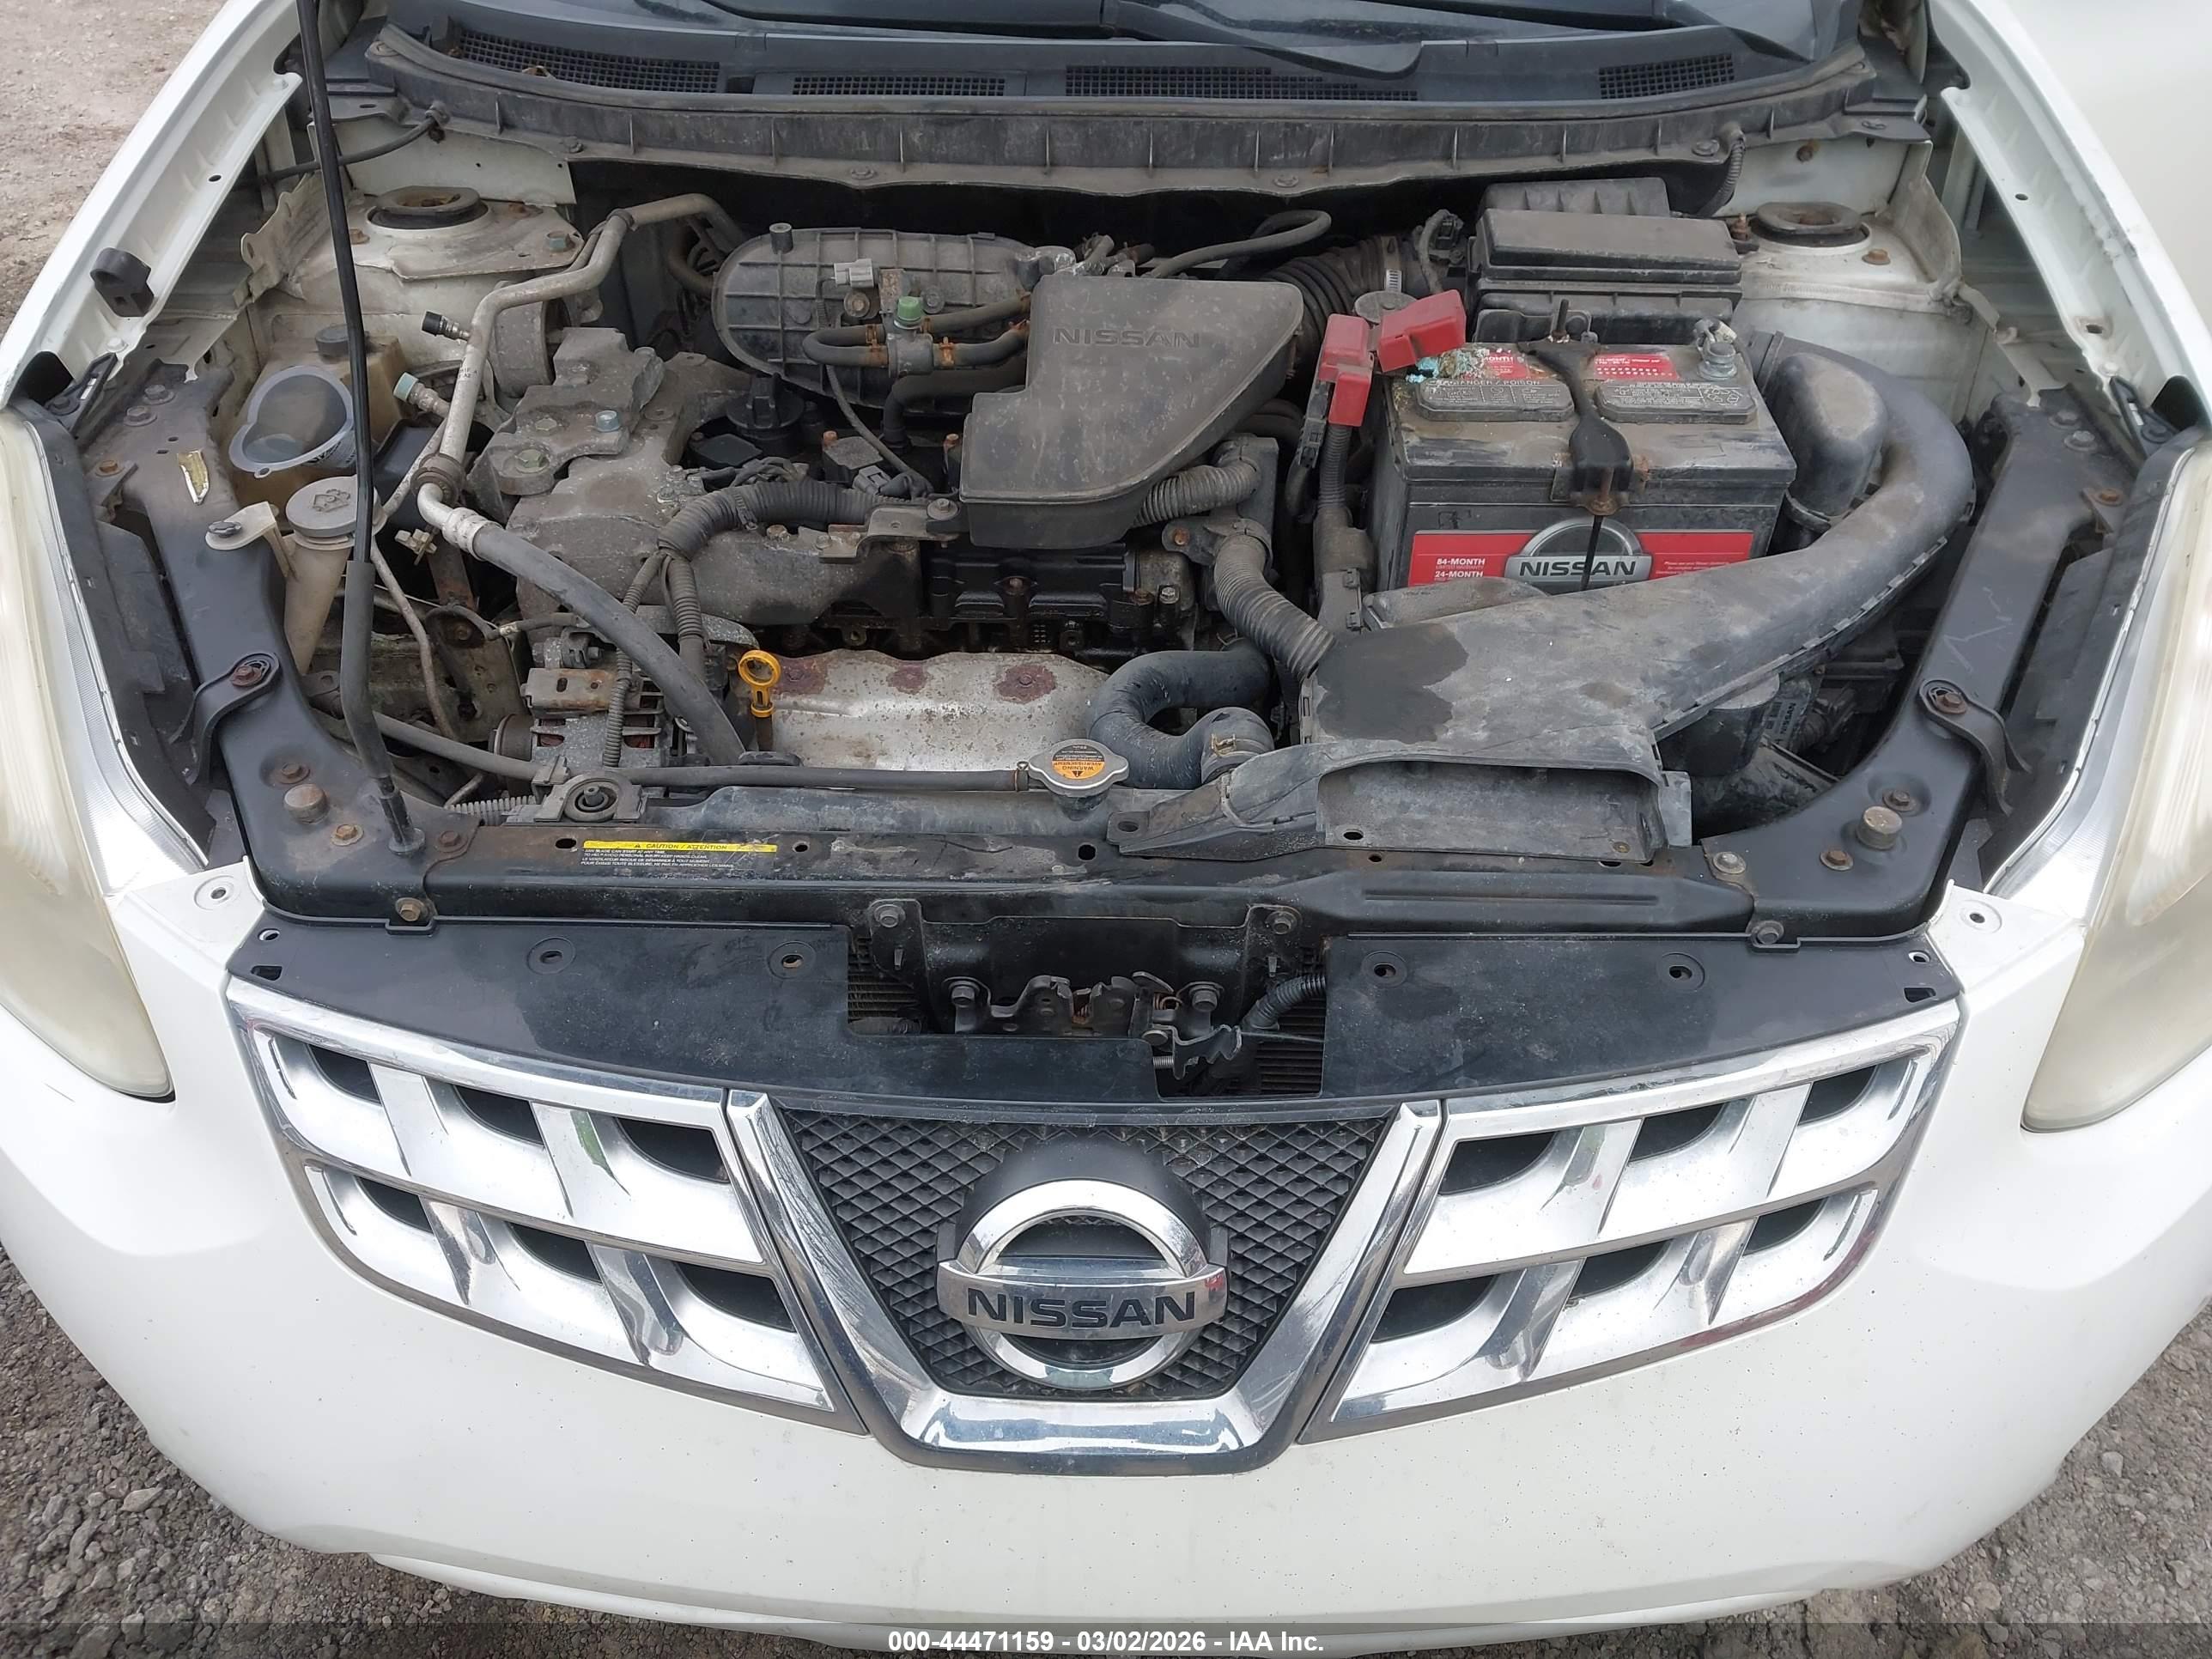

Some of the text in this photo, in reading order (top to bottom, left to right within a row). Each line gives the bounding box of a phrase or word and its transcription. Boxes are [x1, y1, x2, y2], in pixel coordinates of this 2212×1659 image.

[1054, 328, 1200, 348] NISSAN
[1519, 561, 1637, 576] NISSAN
[967, 1287, 1195, 1328] NISSAN
